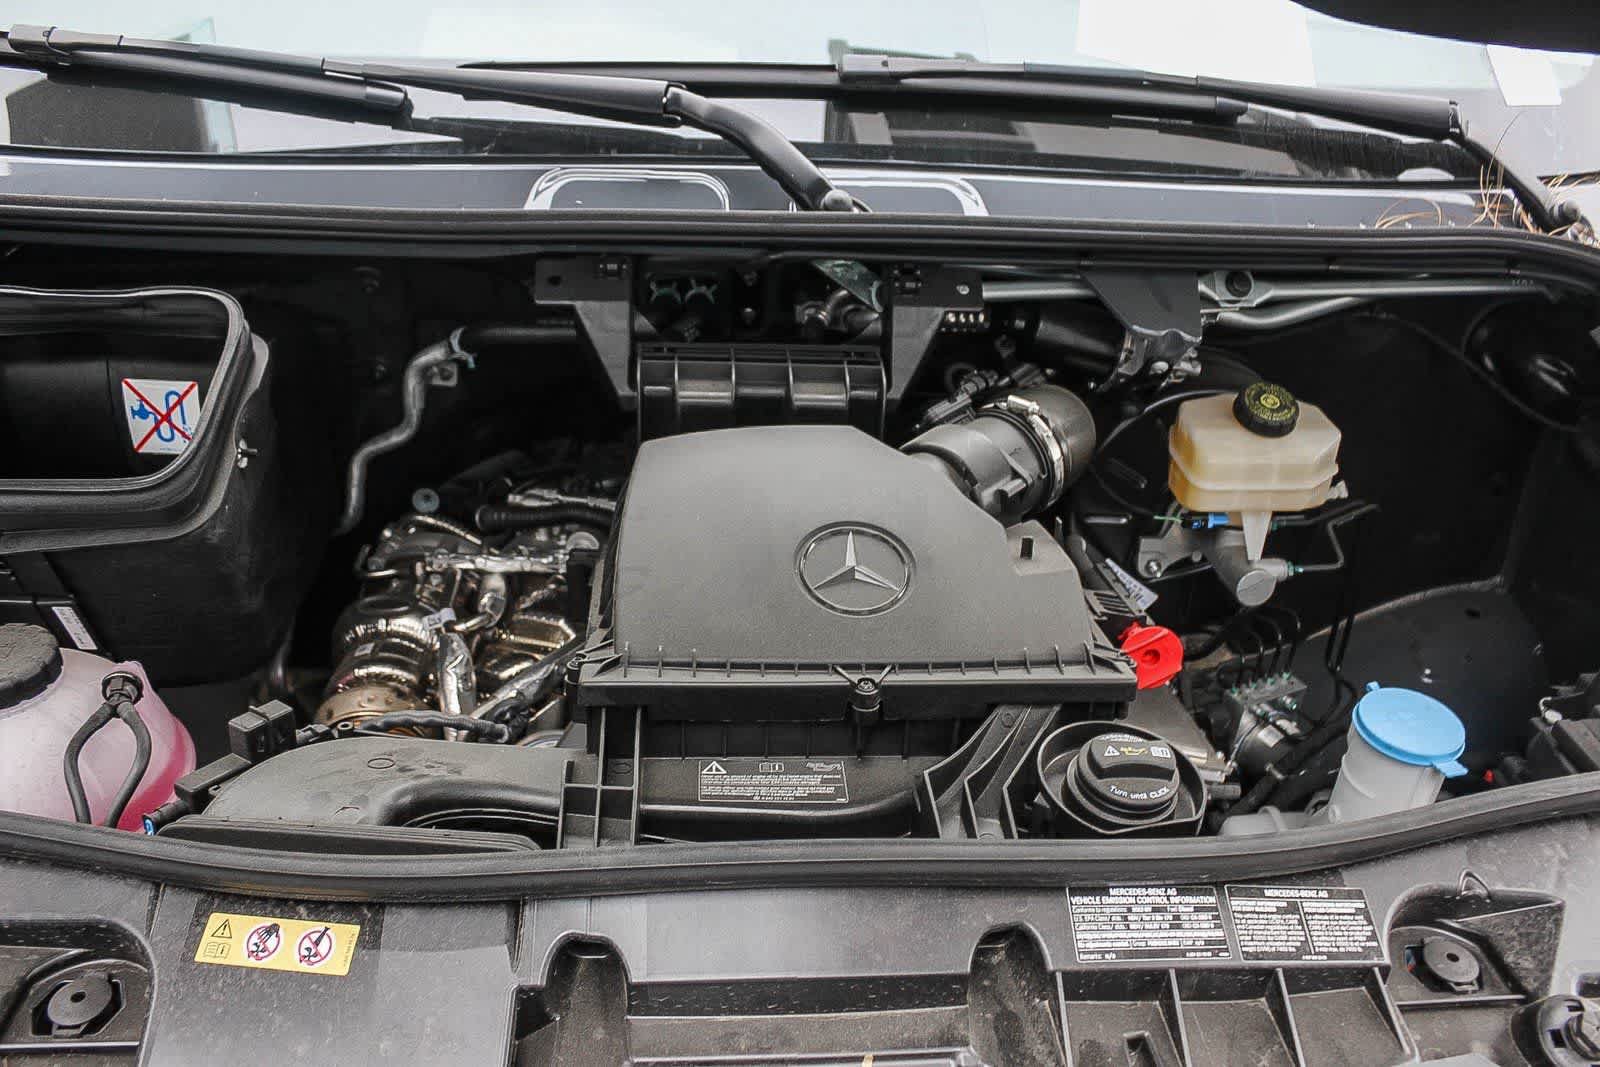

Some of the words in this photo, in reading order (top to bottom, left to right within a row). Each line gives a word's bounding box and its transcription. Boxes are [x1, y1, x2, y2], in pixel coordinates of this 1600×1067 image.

[1110, 785, 1128, 797] Turn
[1130, 792, 1147, 800] until
[1109, 888, 1166, 896] MERCEDES-BENZ
[1264, 889, 1317, 898] MERCEDES-BENZ
[1318, 890, 1328, 898] AG
[1071, 896, 1101, 904] VEHICLE
[1102, 896, 1135, 904] EMISSION
[1136, 896, 1169, 904] CONTROL
[1170, 896, 1216, 904] INFORMATION
